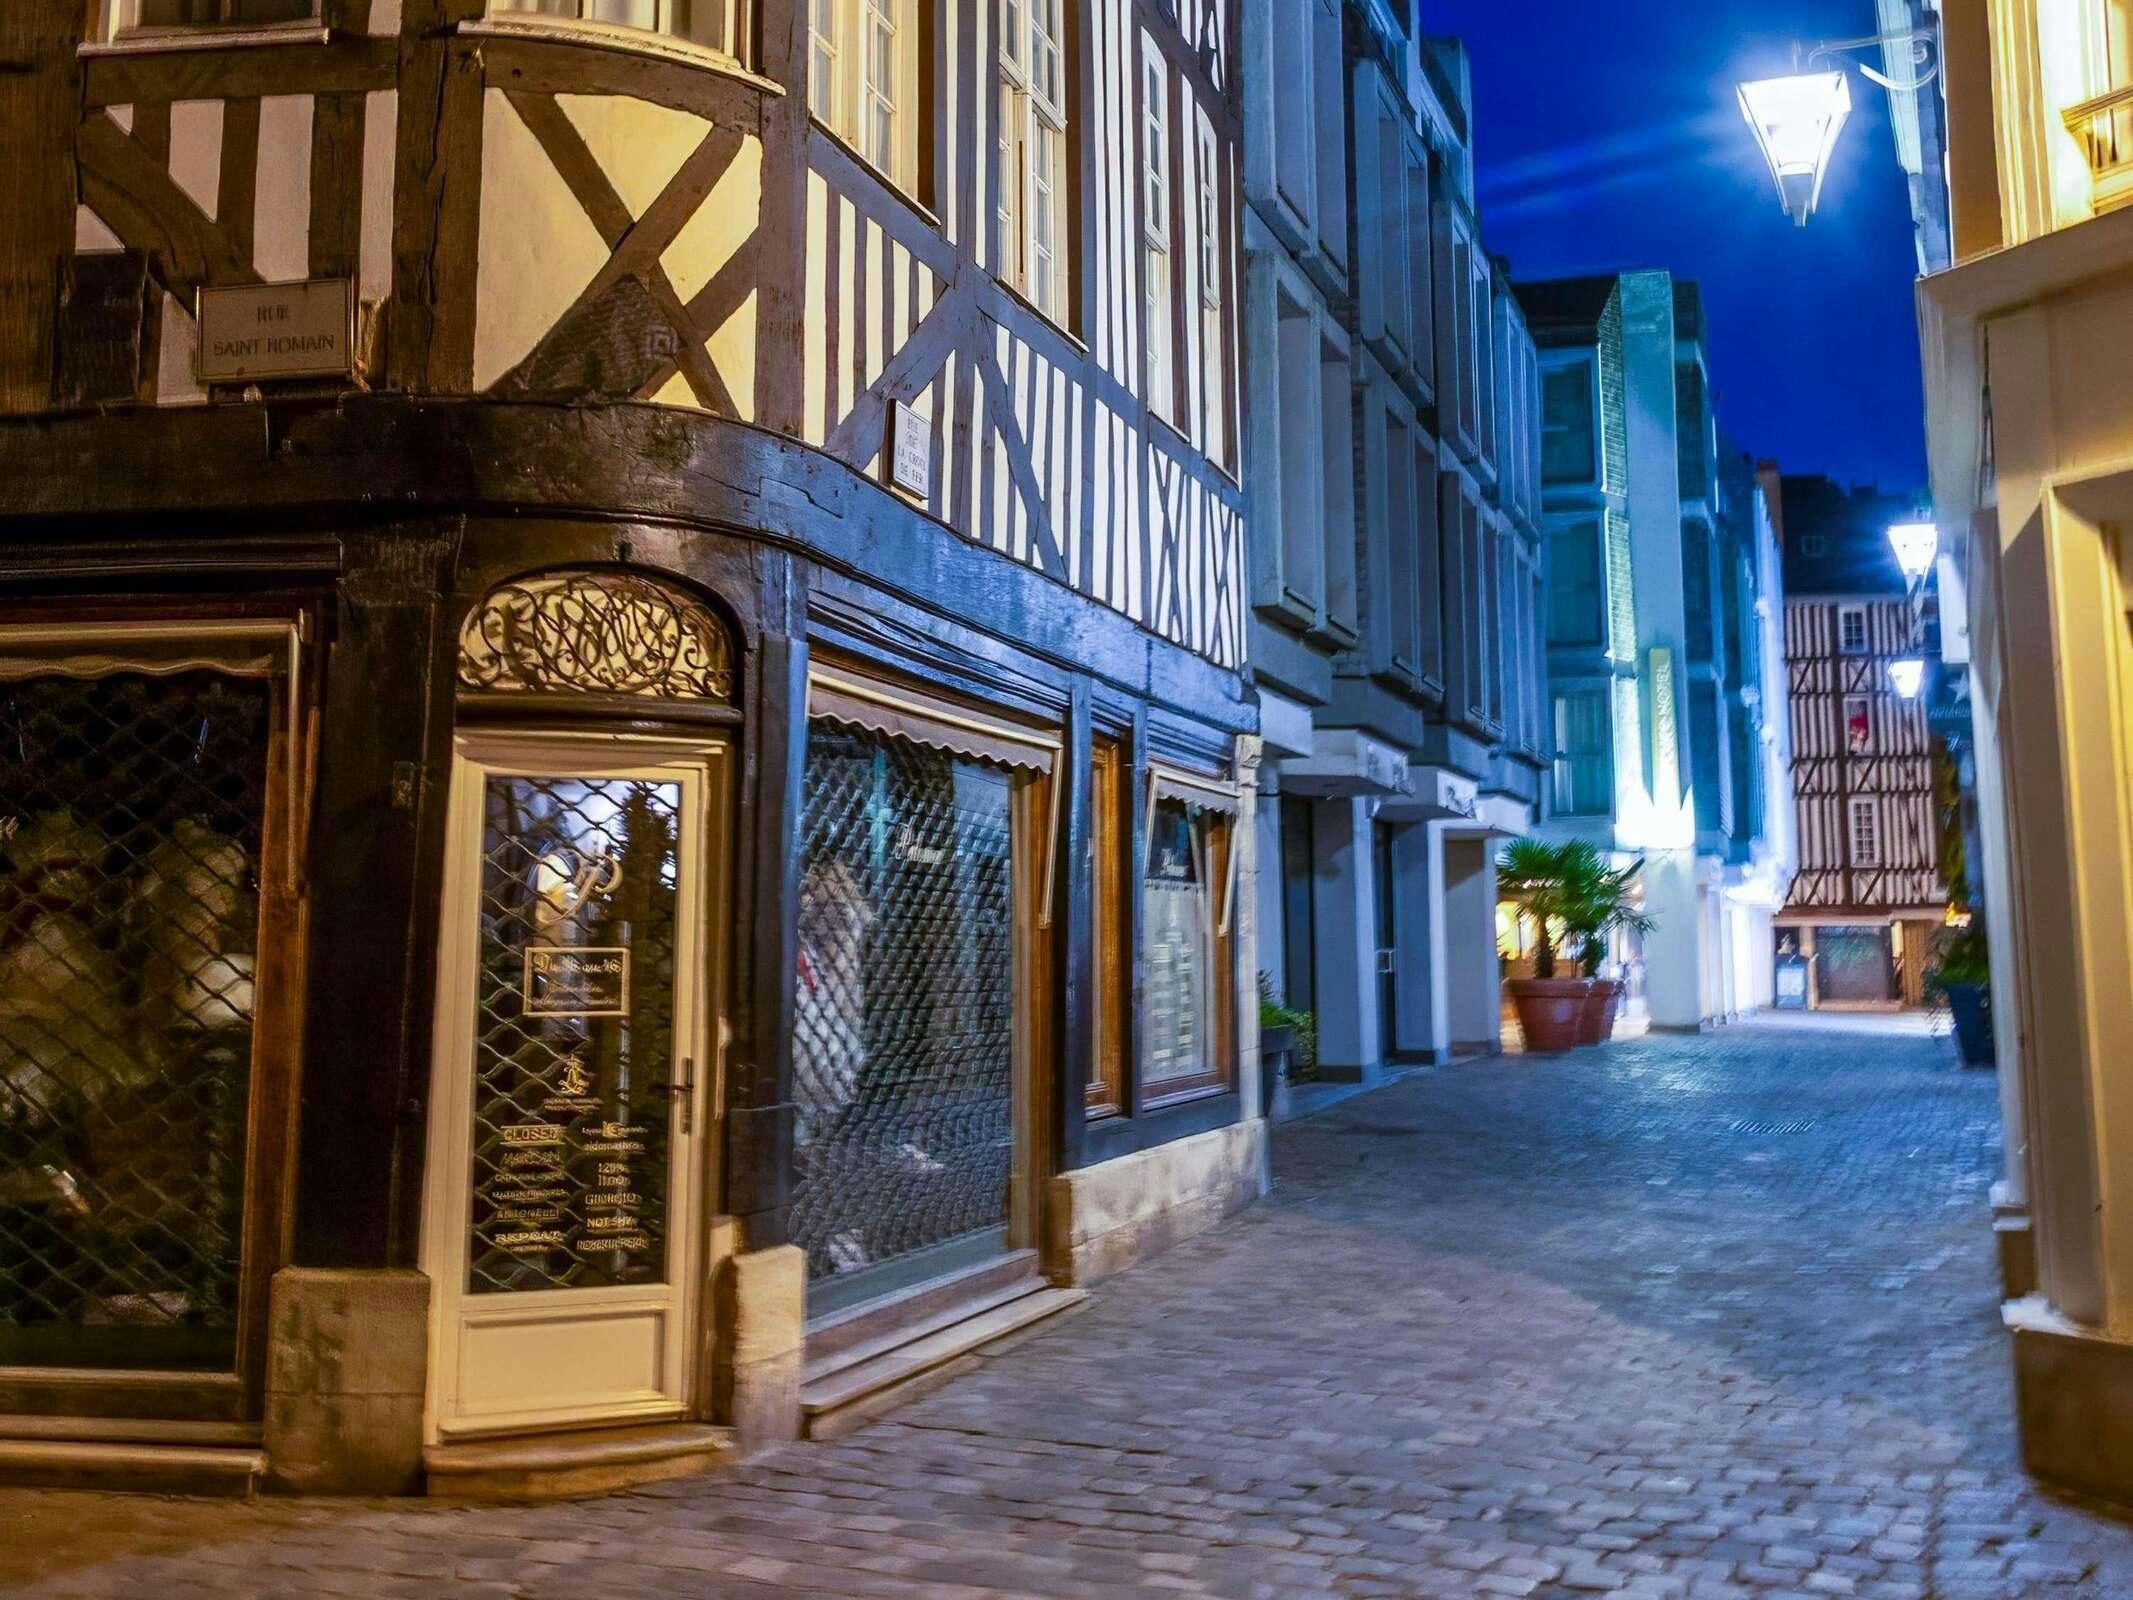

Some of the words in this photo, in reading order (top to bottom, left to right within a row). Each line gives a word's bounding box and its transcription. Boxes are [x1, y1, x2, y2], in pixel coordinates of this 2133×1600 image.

[257, 304, 289, 323] RUE
[213, 338, 259, 357] SAINT
[267, 334, 334, 354] ROMAIN
[503, 1127, 559, 1142] CLOSED
